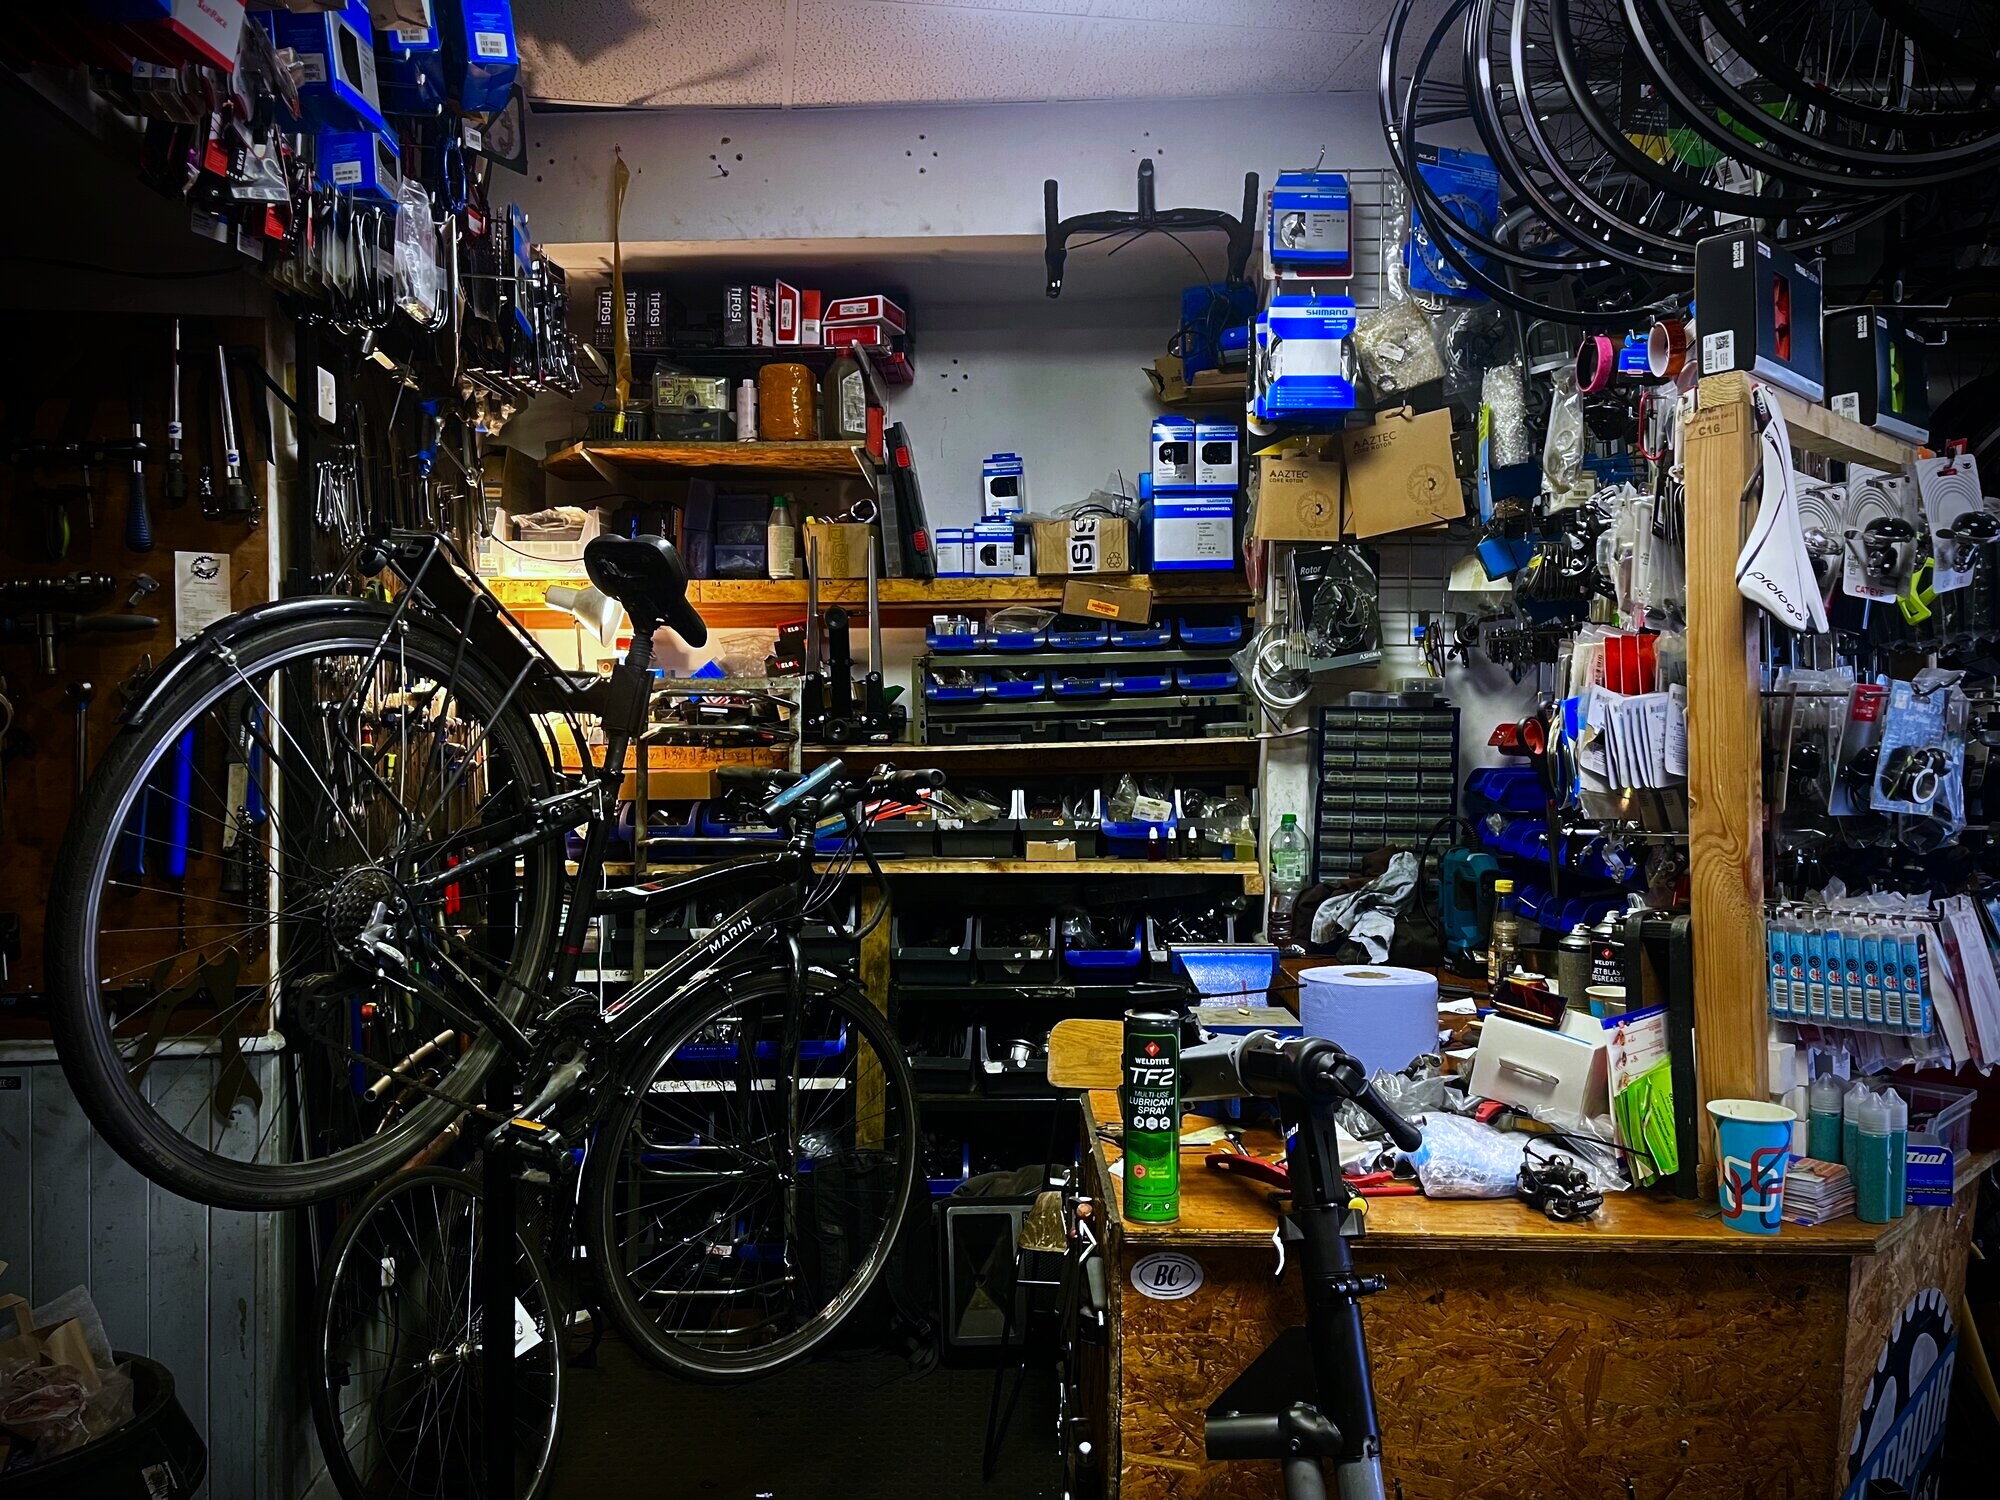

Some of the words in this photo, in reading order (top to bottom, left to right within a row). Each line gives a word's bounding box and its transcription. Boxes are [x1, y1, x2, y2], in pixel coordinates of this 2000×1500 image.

[601, 290, 613, 325] TIFOSI
[650, 291, 661, 327] TIFOSI
[731, 287, 742, 322] TIFOSI
[1698, 423, 1720, 436] C16
[1300, 565, 1322, 576] Rotor
[1747, 570, 1803, 622] prologo
[1854, 584, 1885, 598] CATEYE
[1359, 651, 1382, 660] ASHIMA
[775, 660, 800, 669] VELOX
[708, 915, 752, 954] MARIN
[1134, 1057, 1170, 1065] WELDTITE
[1129, 1066, 1175, 1086] TF2
[1134, 1090, 1170, 1098] MULTI-USE
[1129, 1096, 1175, 1107] LUBRICANT
[1138, 1106, 1167, 1115] SPRAY
[1154, 1264, 1181, 1286] BC
